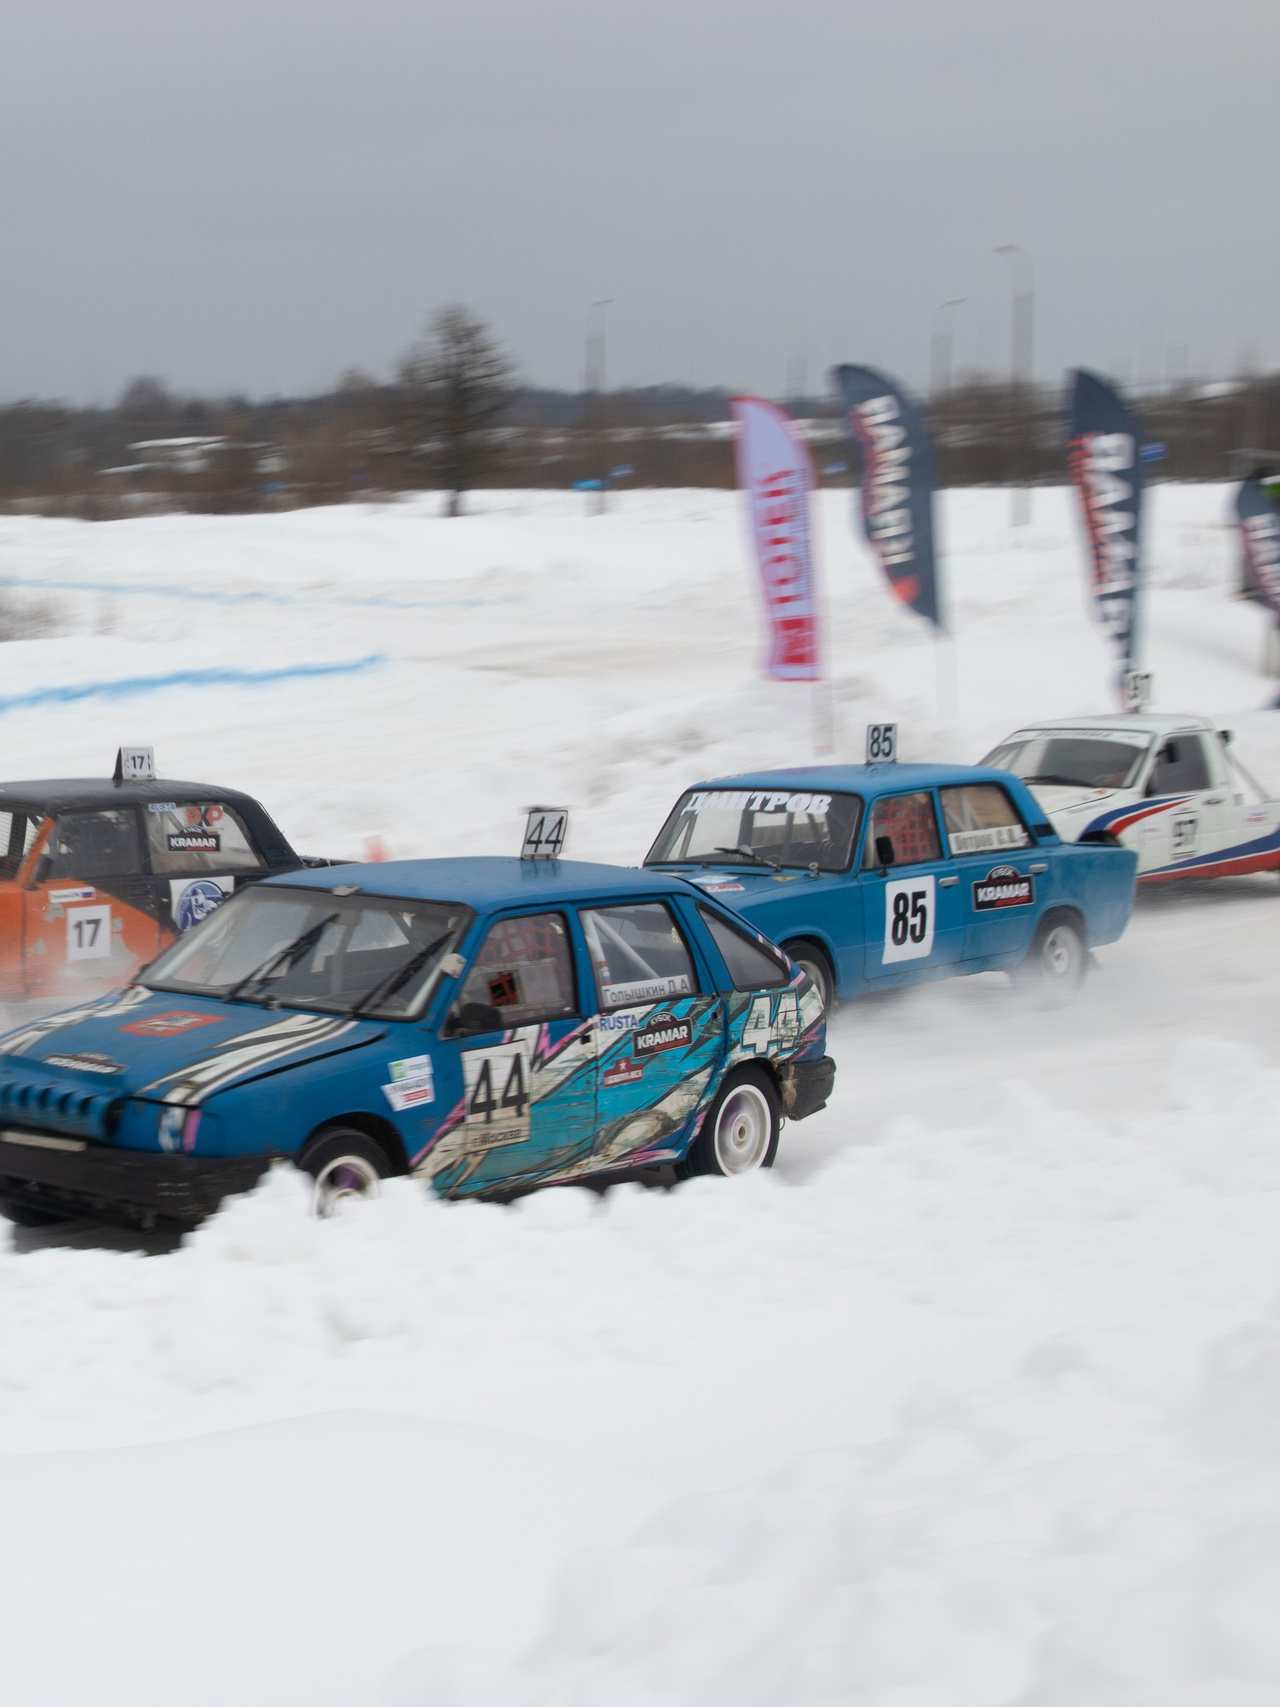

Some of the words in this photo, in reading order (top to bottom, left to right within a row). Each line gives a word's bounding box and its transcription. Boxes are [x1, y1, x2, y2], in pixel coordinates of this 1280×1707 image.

[871, 726, 893, 758] 85
[131, 756, 144, 769] 17
[681, 791, 832, 816] ДМИТРОВ
[170, 838, 216, 848] KRAMAR
[526, 816, 564, 853] 44
[977, 882, 1029, 902] KRAMAR
[891, 891, 927, 946] 85
[73, 919, 103, 949] 17
[600, 1014, 638, 1031] RUSTA
[742, 992, 799, 1054] 44
[637, 1025, 688, 1049] KRAMAR
[469, 1052, 530, 1125] 44
